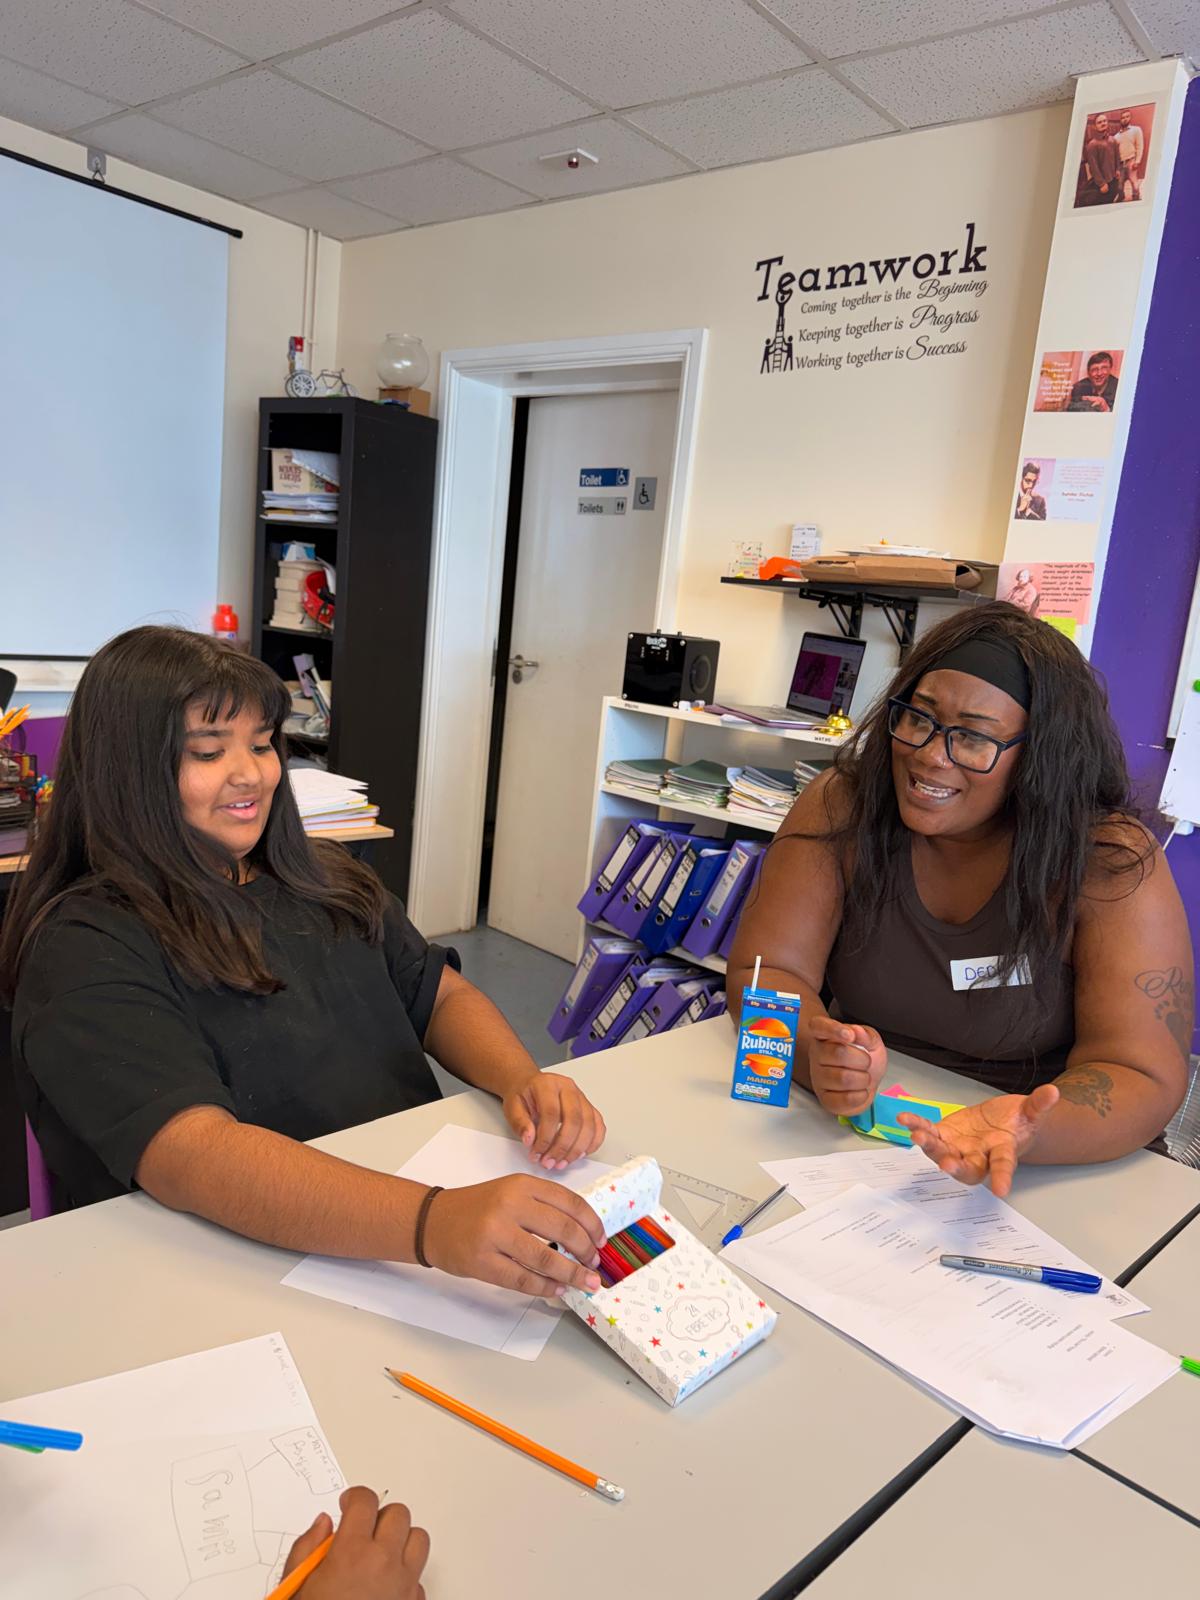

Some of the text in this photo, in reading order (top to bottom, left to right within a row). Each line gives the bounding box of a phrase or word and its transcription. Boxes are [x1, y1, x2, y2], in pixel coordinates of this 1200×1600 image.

[754, 222, 987, 302] Teamwork
[800, 278, 989, 315] Coming together is the Beginning
[799, 304, 980, 344] Keeping together is Progress
[795, 335, 968, 370] Working together is Success
[581, 474, 602, 486] Toilet
[578, 503, 604, 513] Toilets
[741, 1035, 793, 1057] Rubicon
[747, 1076, 778, 1085] MANGO
[685, 1303, 701, 1318] 24
